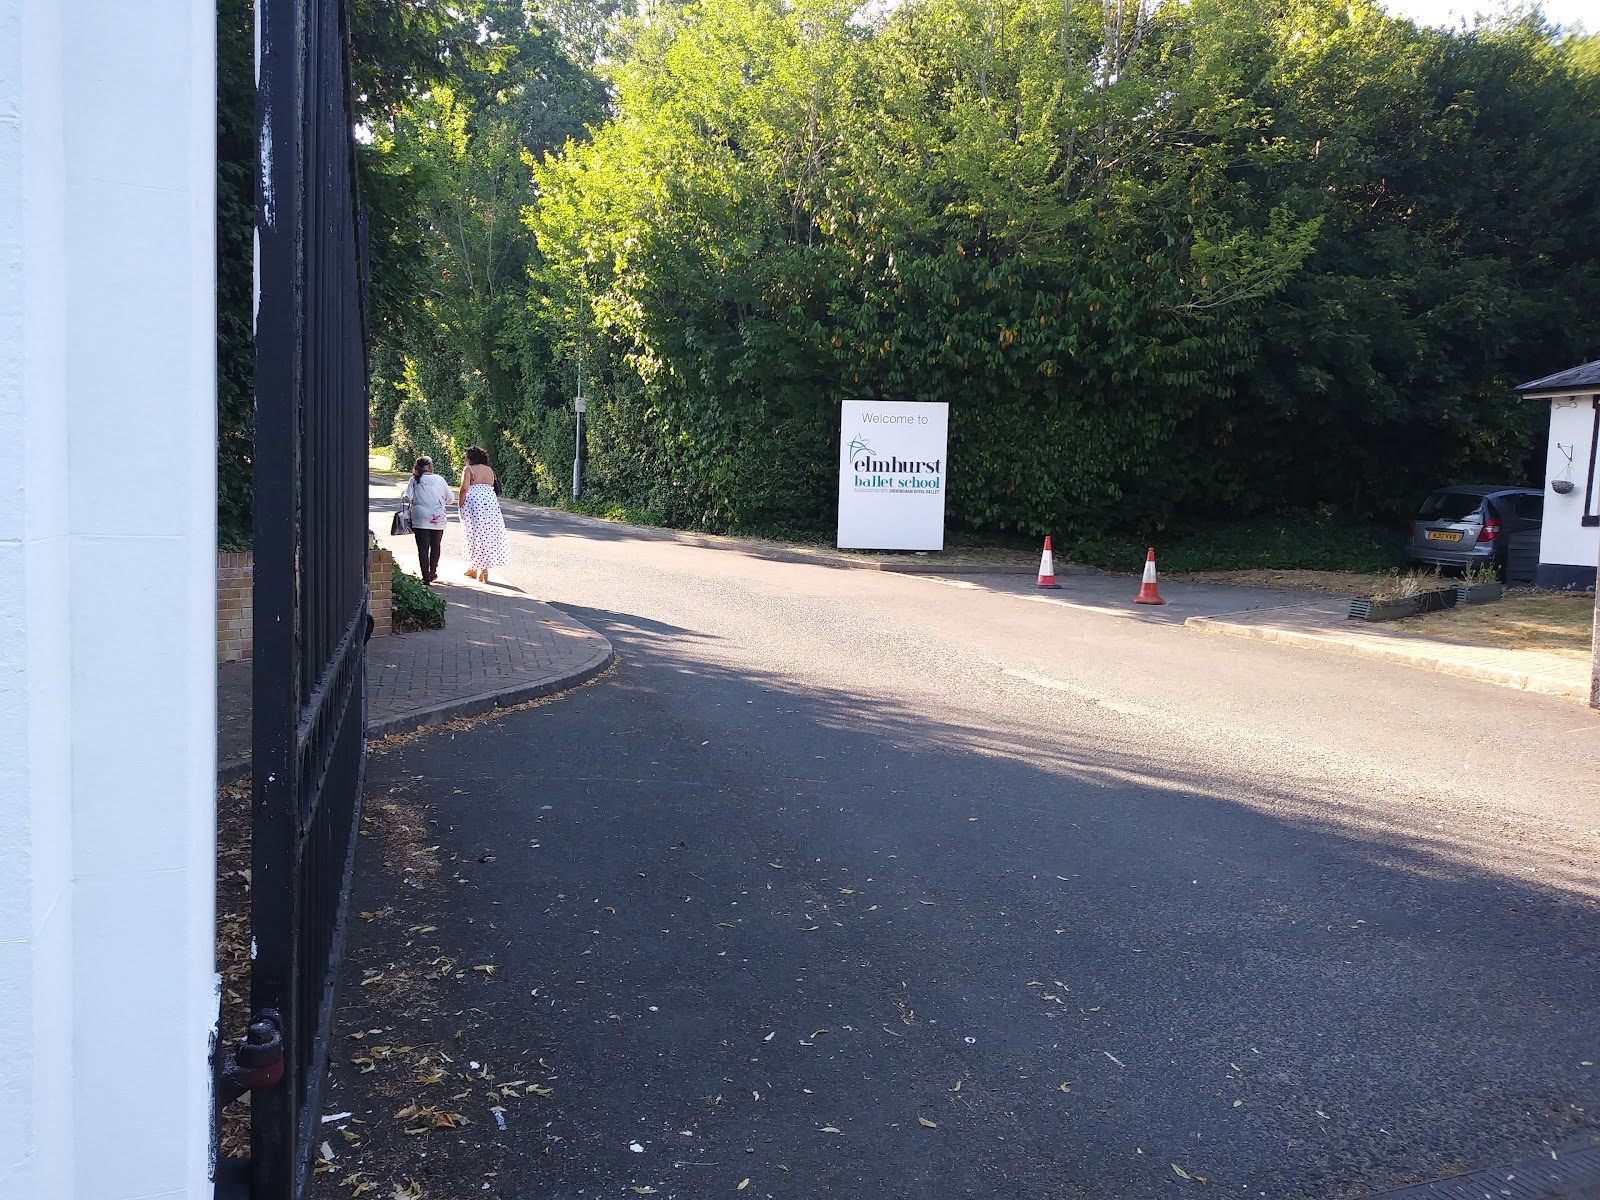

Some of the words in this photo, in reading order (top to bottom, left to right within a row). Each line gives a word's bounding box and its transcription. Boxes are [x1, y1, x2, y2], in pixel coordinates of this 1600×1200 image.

[862, 412, 914, 424] Welcome
[917, 414, 928, 424] to
[854, 455, 942, 474] elmhurst
[854, 474, 894, 488] ballet
[898, 475, 940, 489] school
